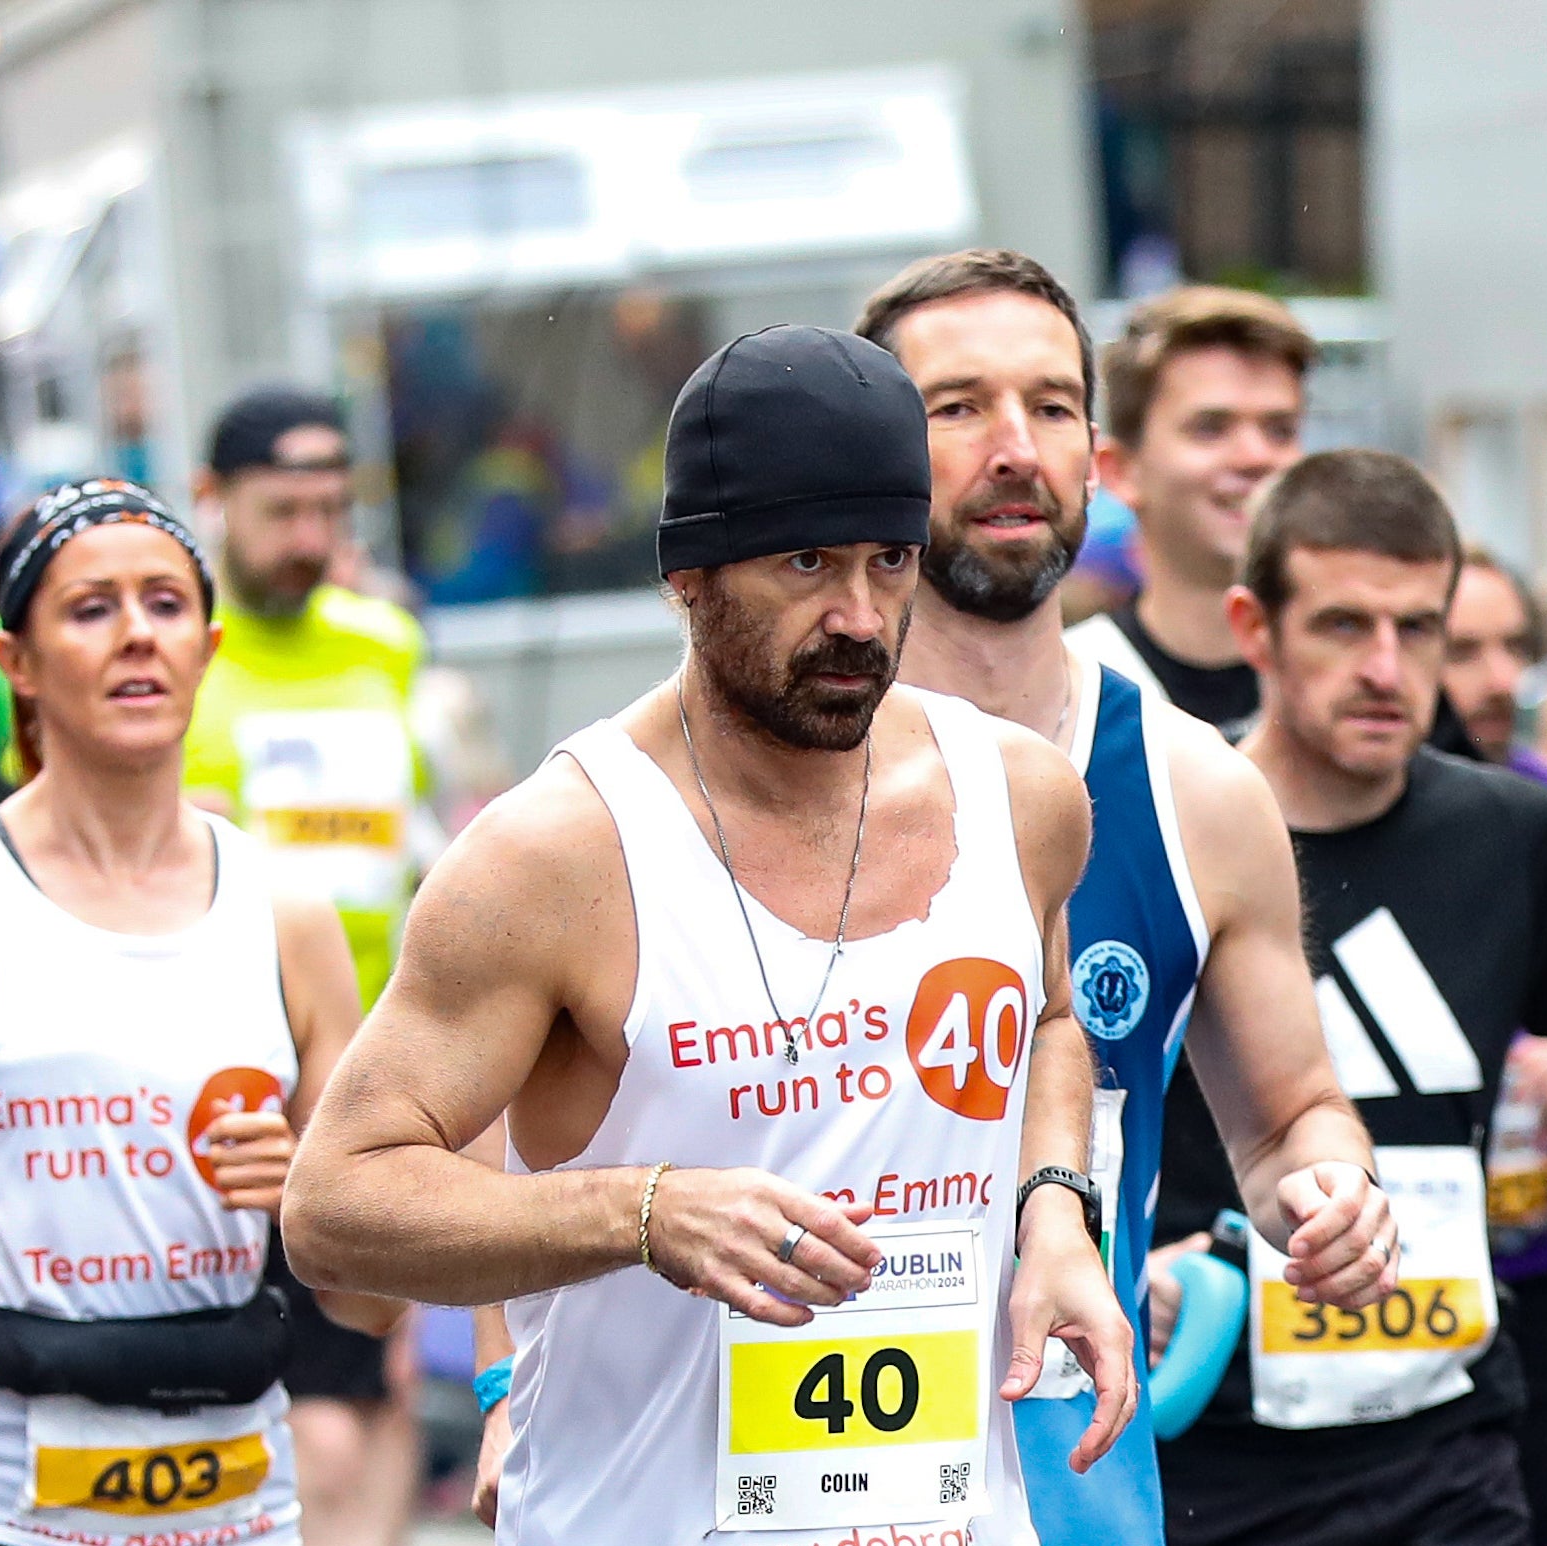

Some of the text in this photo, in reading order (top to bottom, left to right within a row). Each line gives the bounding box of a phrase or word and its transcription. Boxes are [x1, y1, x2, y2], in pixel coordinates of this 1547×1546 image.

[668, 998, 889, 1069] Emma's
[917, 985, 1024, 1091] 40
[729, 1062, 892, 1120] run to
[24, 1142, 175, 1180] run to
[24, 1248, 151, 1285] Team
[937, 1276, 965, 1288] 2024
[794, 1348, 919, 1433] 40
[91, 1450, 220, 1506] 403
[821, 1473, 868, 1493] COLIN
